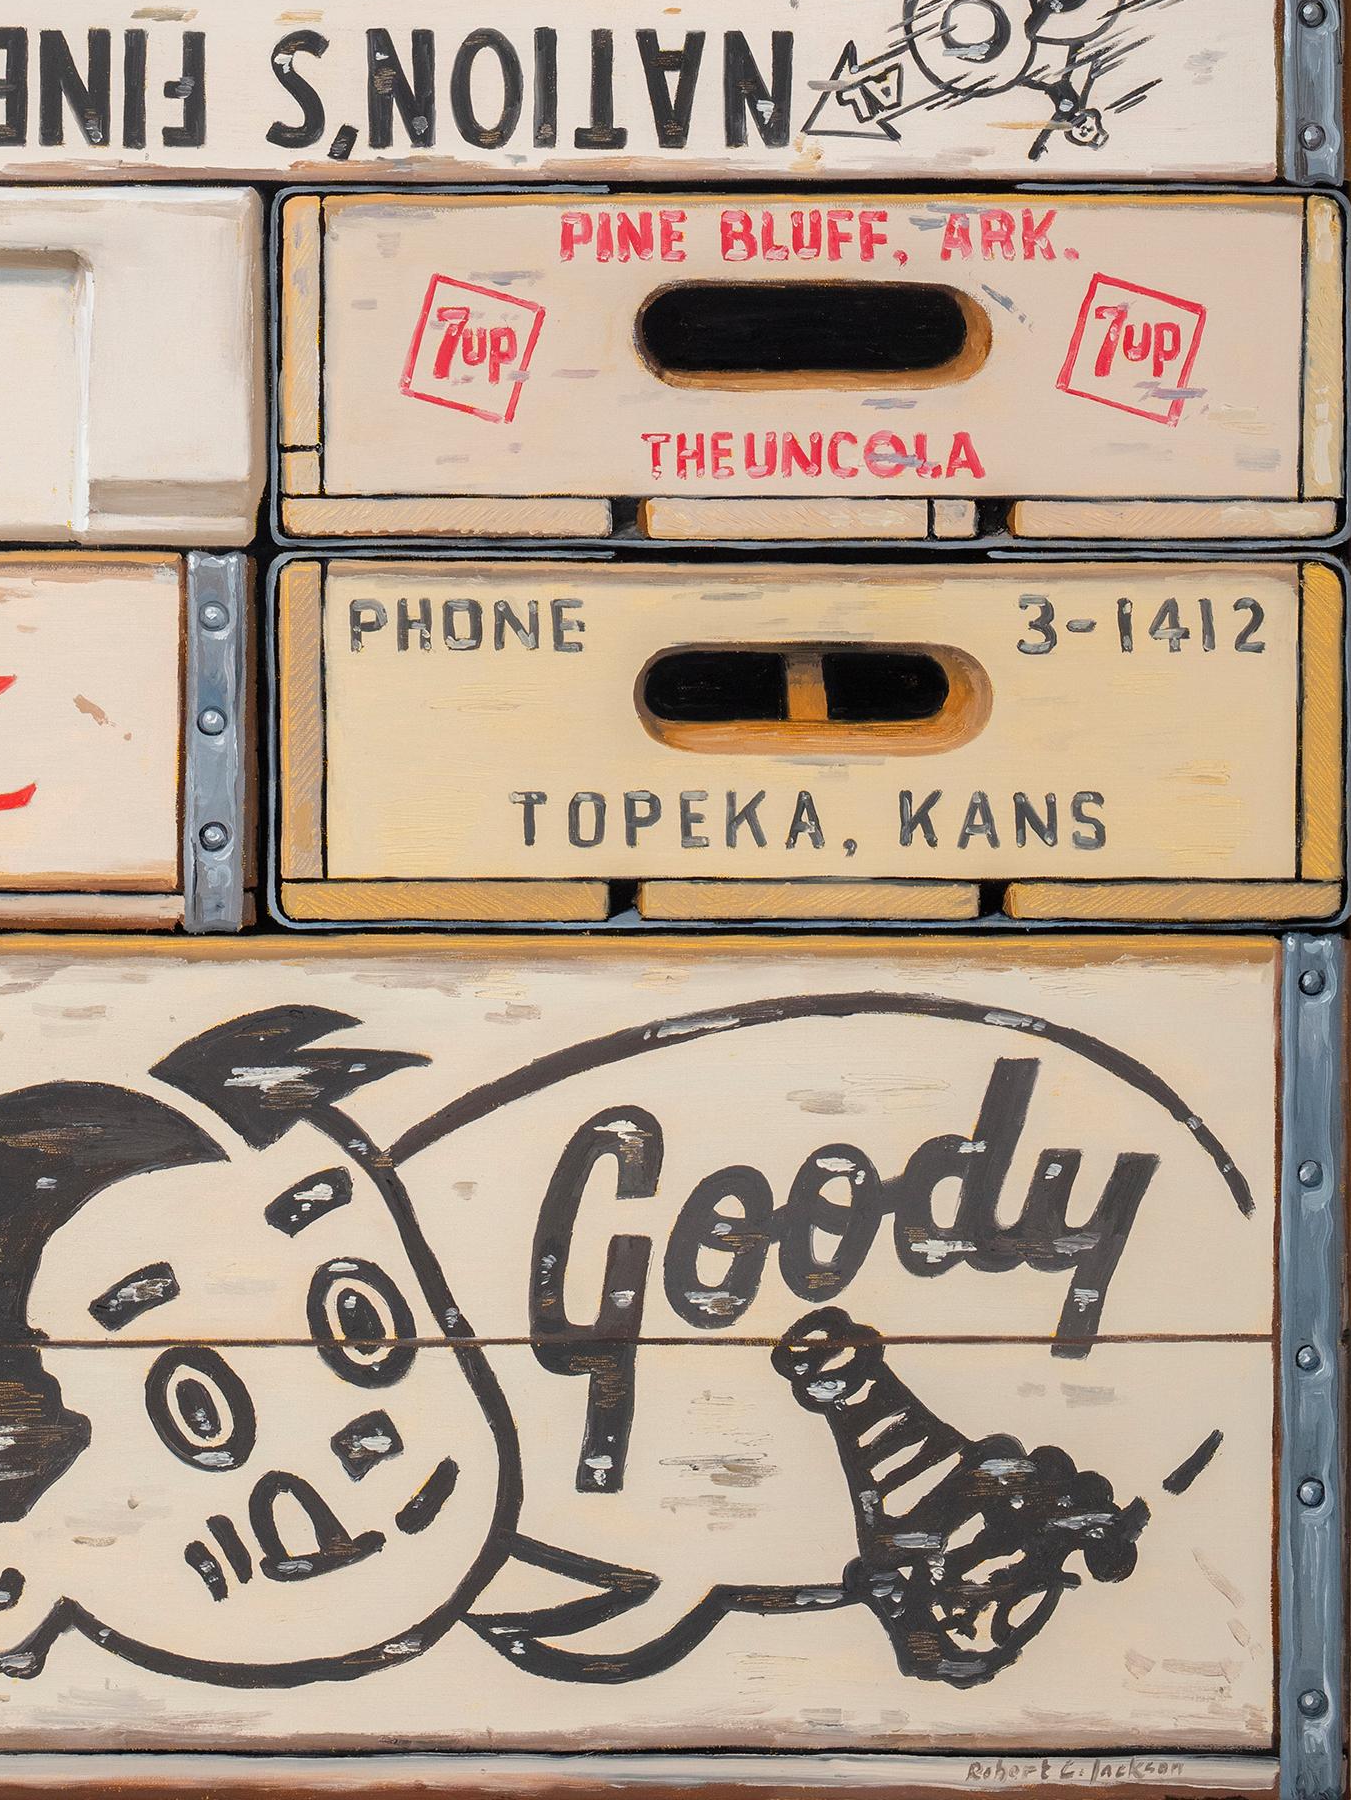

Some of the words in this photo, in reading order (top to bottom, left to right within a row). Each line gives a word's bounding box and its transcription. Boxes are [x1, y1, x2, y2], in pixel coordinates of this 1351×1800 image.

[264, 26, 795, 160] NATION'S
[558, 208, 686, 264] PINE
[720, 208, 910, 268] BLUFF,
[939, 207, 1080, 263] ARK.
[433, 306, 518, 385] 7up
[1094, 304, 1182, 378] 7up
[348, 596, 587, 654] PHONE
[1016, 595, 1267, 656] 3-1412
[508, 788, 860, 859] TOPEKA,
[898, 788, 1108, 852] KANS
[529, 1056, 1161, 1493] Goody
[965, 1758, 1050, 1782] Robert
[1090, 1756, 1185, 1783] Jackson
